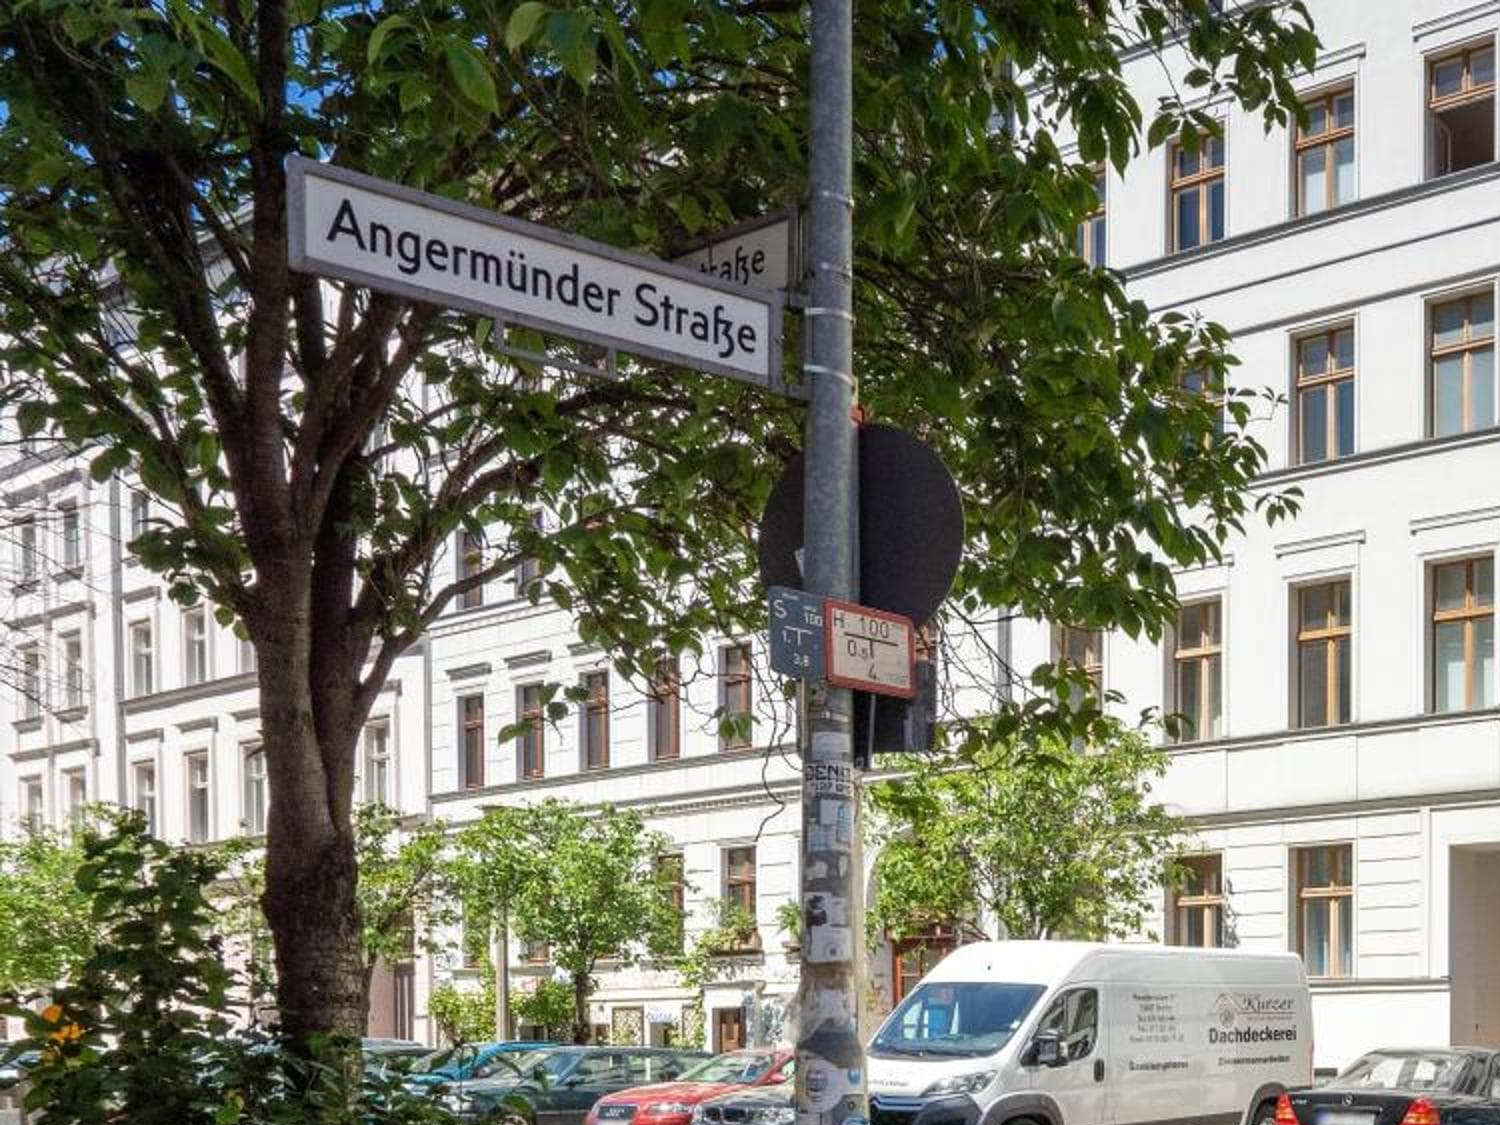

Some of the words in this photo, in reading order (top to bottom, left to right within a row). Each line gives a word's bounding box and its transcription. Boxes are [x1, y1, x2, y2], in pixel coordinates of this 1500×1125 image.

[326, 198, 620, 317] Angermünder
[634, 282, 757, 359] Straße
[860, 617, 889, 639] 100
[1208, 1024, 1297, 1044] Dachdeckerei
